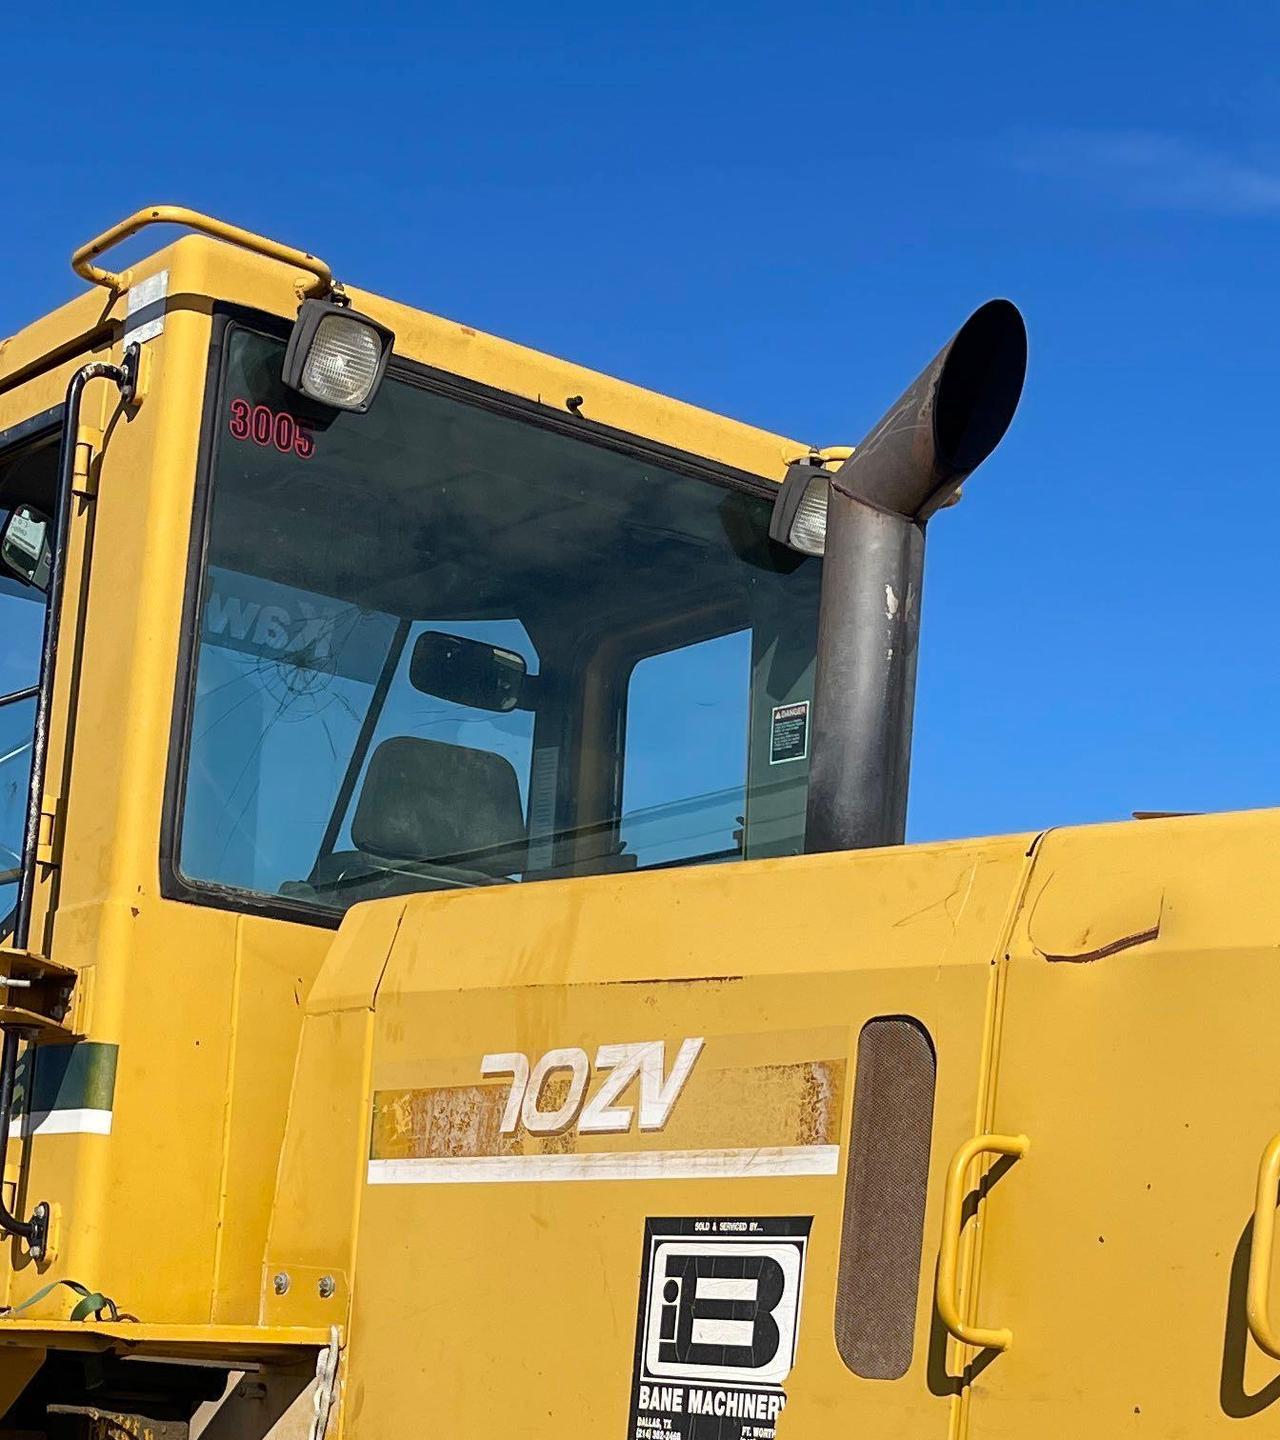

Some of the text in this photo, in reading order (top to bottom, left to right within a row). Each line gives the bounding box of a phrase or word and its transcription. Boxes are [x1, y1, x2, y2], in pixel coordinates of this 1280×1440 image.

[228, 398, 316, 460] 3005
[480, 1037, 705, 1137] 70ZV
[638, 1385, 684, 1413] BANE
